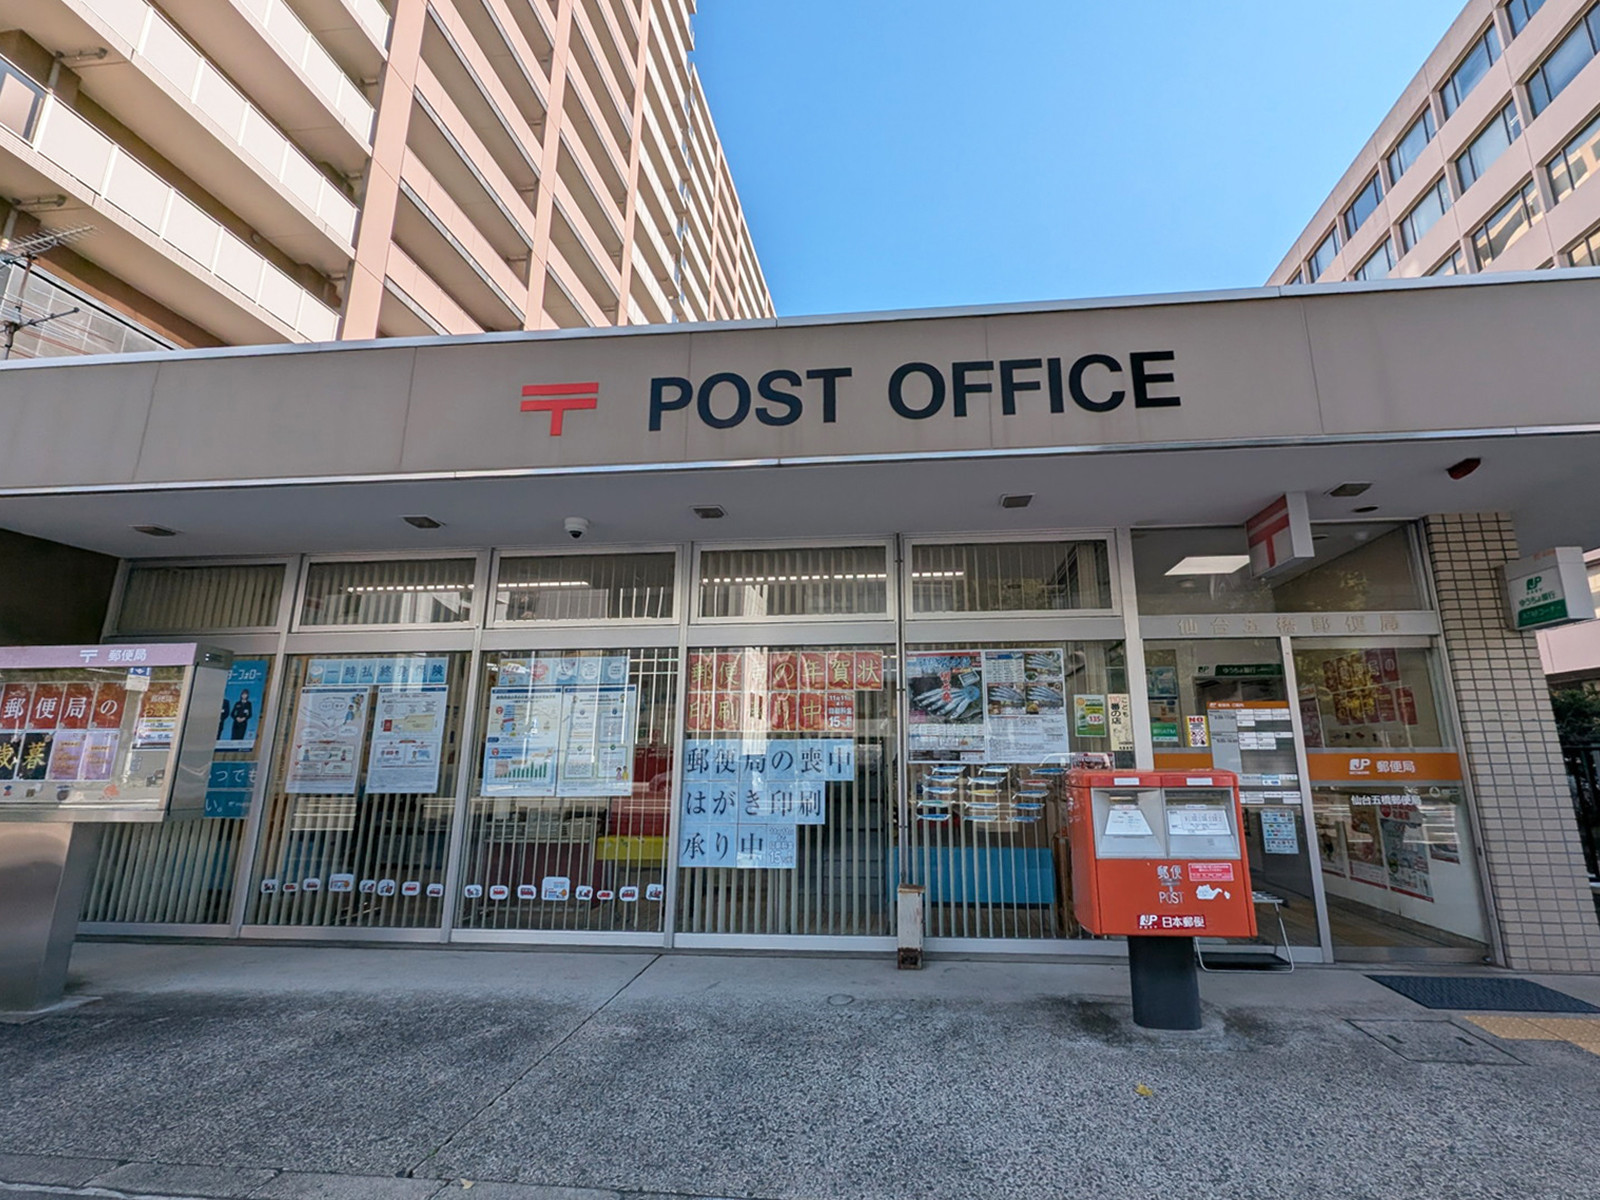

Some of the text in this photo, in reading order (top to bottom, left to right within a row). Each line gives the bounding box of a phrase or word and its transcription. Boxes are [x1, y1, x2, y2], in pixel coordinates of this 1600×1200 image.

[648, 350, 1182, 432] POST OFFICE
[107, 648, 147, 662] 郵便局
[690, 659, 880, 686] 郵便の年賀状
[3, 697, 118, 719] 郵便局の
[689, 700, 823, 725] 印刷り中
[686, 747, 851, 774] 郵便局の喪中
[1376, 760, 1416, 773] 郵便局
[686, 789, 822, 817] はがき印刷
[1350, 794, 1422, 806] 仙台五橋郵便局
[683, 832, 764, 860] 承り中
[1157, 865, 1183, 879] 郵便
[1158, 891, 1184, 904] POST
[1162, 916, 1205, 928] 日本郵便
